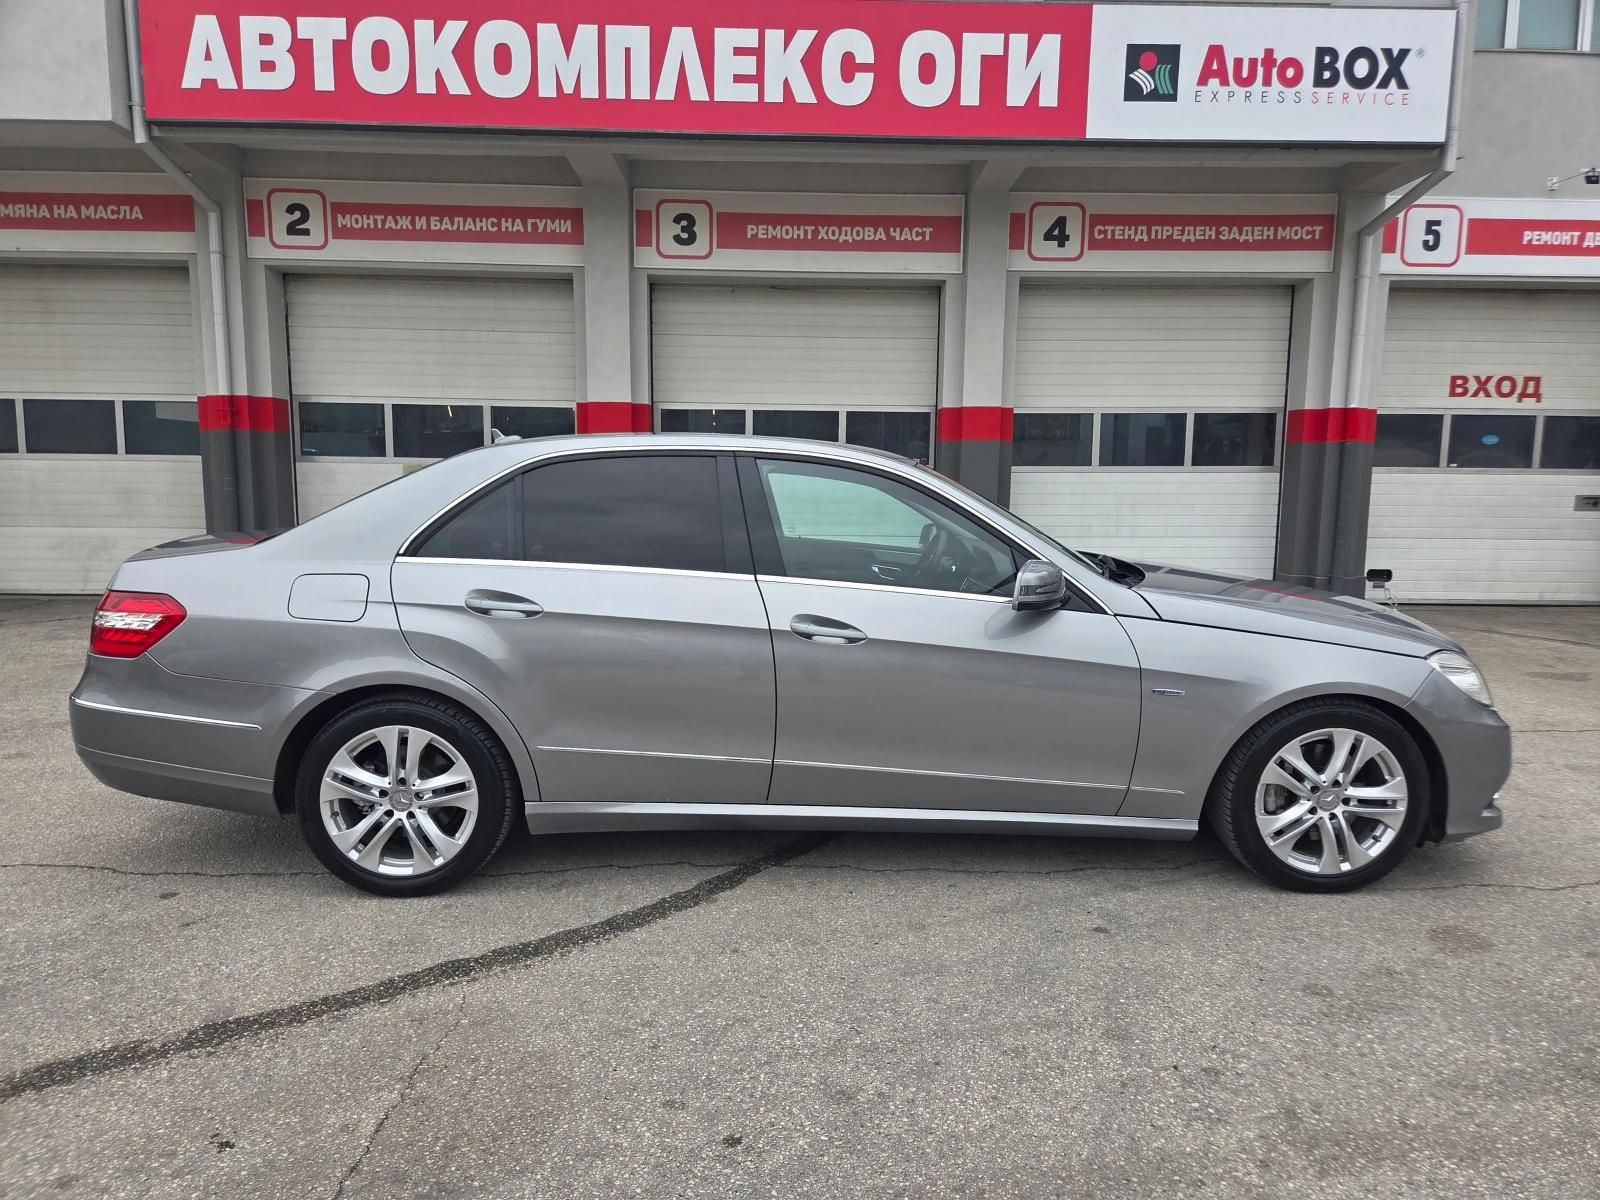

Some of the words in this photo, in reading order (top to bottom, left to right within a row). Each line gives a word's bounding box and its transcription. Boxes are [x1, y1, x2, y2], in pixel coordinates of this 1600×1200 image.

[181, 14, 875, 107] АВТОКОМПЛЕКС
[899, 30, 1062, 108] ОГИ
[1196, 44, 1304, 88] Auto
[1194, 91, 1302, 104] EXPRESS
[1311, 91, 1410, 106] SERVICE
[0, 203, 51, 219] МЯНА
[53, 204, 78, 219] НА
[81, 205, 144, 220] МАСЛА
[284, 202, 311, 236] 2
[337, 213, 413, 230] МОНТАЖ
[415, 215, 427, 230] И
[431, 216, 498, 232] БАЛАНС
[501, 217, 525, 232] НА
[528, 218, 572, 234] ГУМИ
[671, 213, 697, 247] 3
[747, 225, 815, 240] РЕМОНТ
[817, 226, 887, 243] ХОДОВА
[889, 227, 933, 242] ЧАСТ
[1043, 216, 1070, 248] 4
[1094, 225, 1149, 242] СТЕНД
[1151, 226, 1216, 243] ПРЕДЕН
[1218, 226, 1274, 243] ЗАДЕН
[1277, 226, 1324, 240] МОСТ
[1422, 220, 1442, 252] 5
[1522, 230, 1581, 246] РЕМОНТ
[1448, 375, 1542, 403] ВХОД
